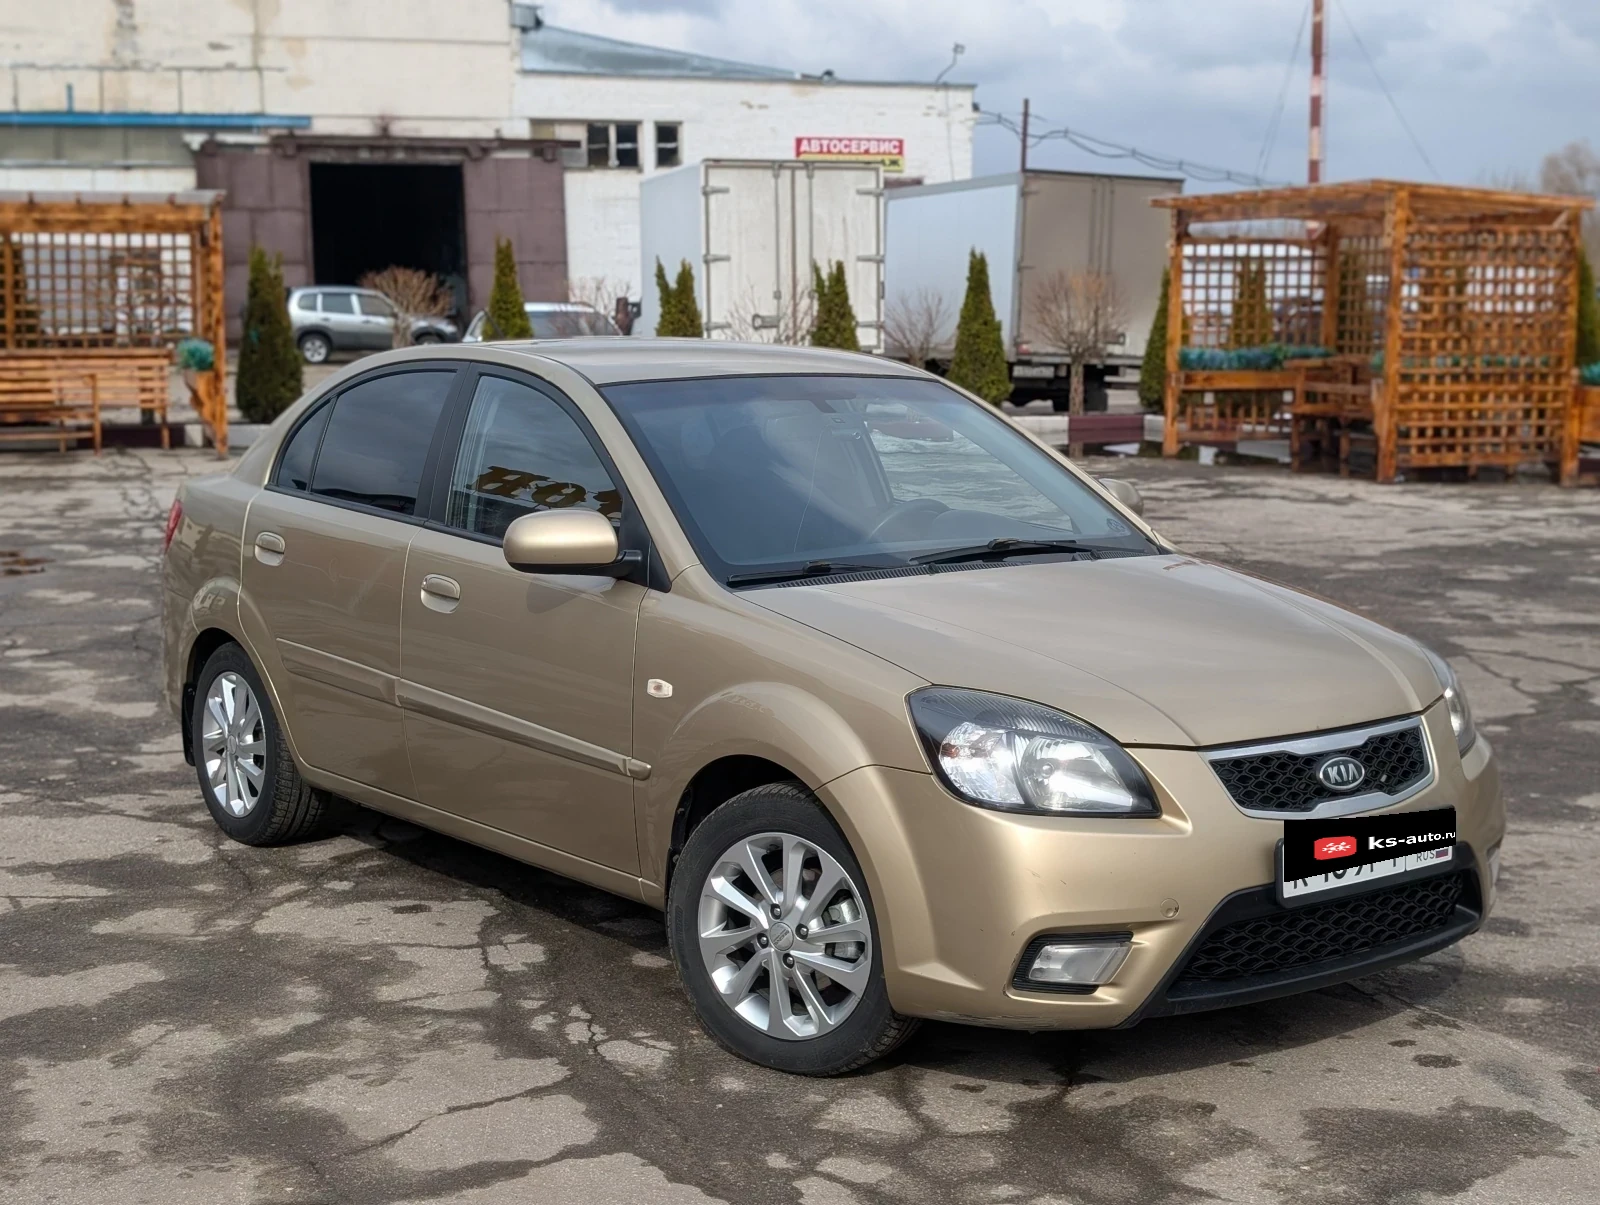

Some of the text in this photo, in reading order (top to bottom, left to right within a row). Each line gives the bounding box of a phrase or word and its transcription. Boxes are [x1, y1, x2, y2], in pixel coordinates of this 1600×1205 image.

[800, 139, 900, 154] АВТОСЕРВИС
[1327, 763, 1360, 784] KIA
[1416, 849, 1435, 863] RUS
